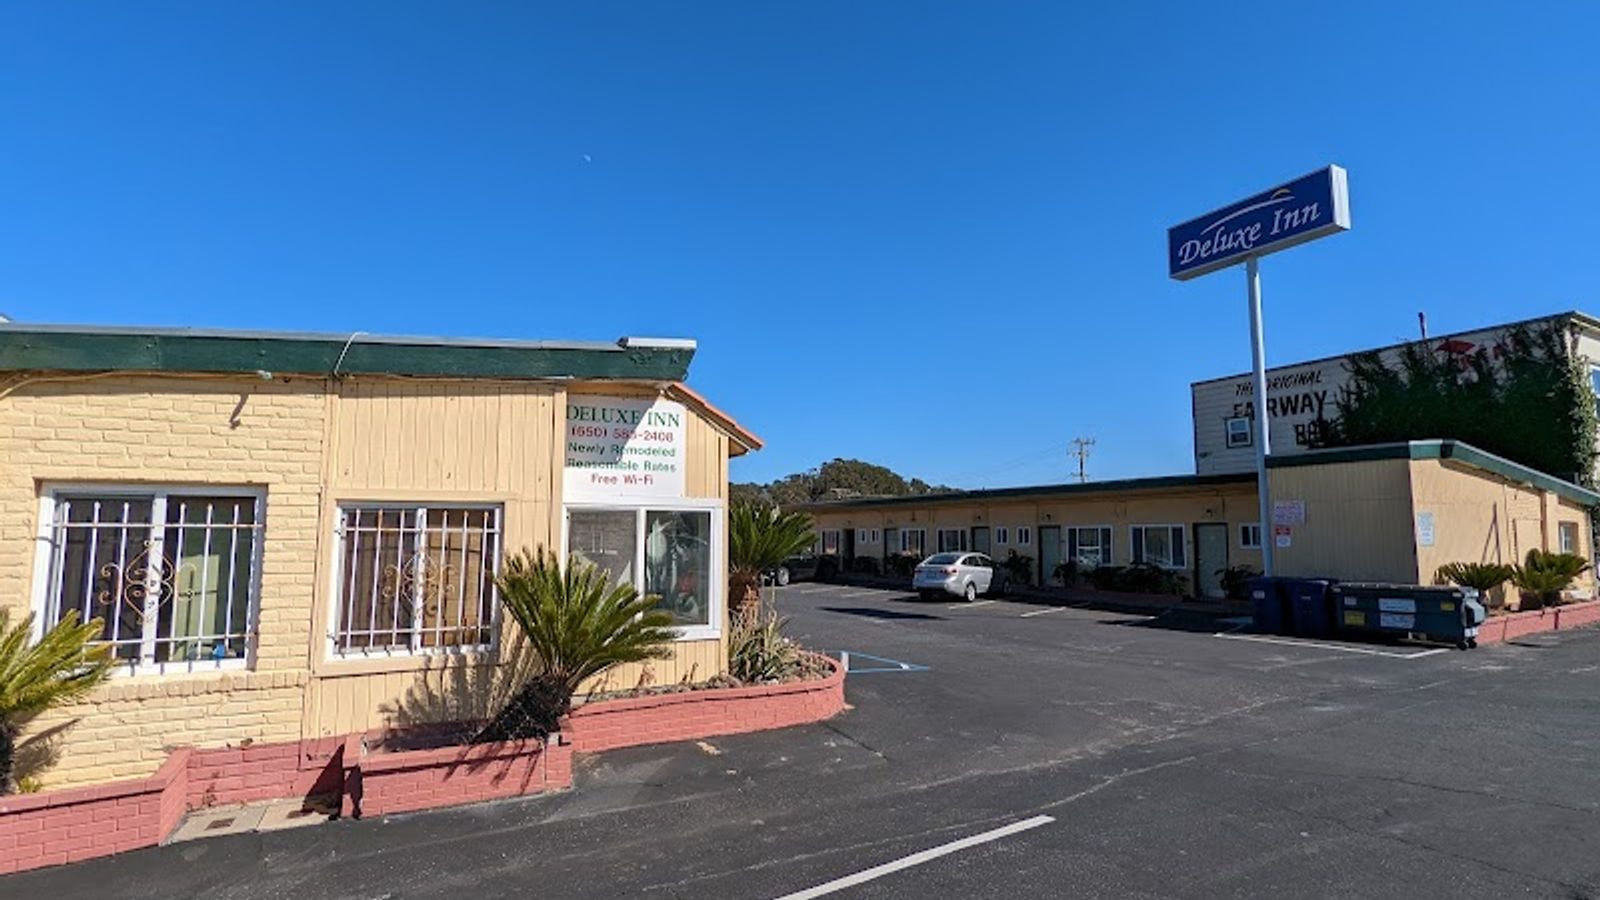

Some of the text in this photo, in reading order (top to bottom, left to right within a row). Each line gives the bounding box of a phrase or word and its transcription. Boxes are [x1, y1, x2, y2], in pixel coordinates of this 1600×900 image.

[1178, 202, 1320, 265] Deluxe Inn
[1234, 390, 1327, 420] FARWAY
[566, 404, 680, 428] DELUXE INN
[571, 426, 608, 439] (650)
[568, 441, 676, 457] Newly Remodeled
[567, 458, 678, 473] Reasonable Rates
[591, 473, 654, 485] Free Wi-Fi
